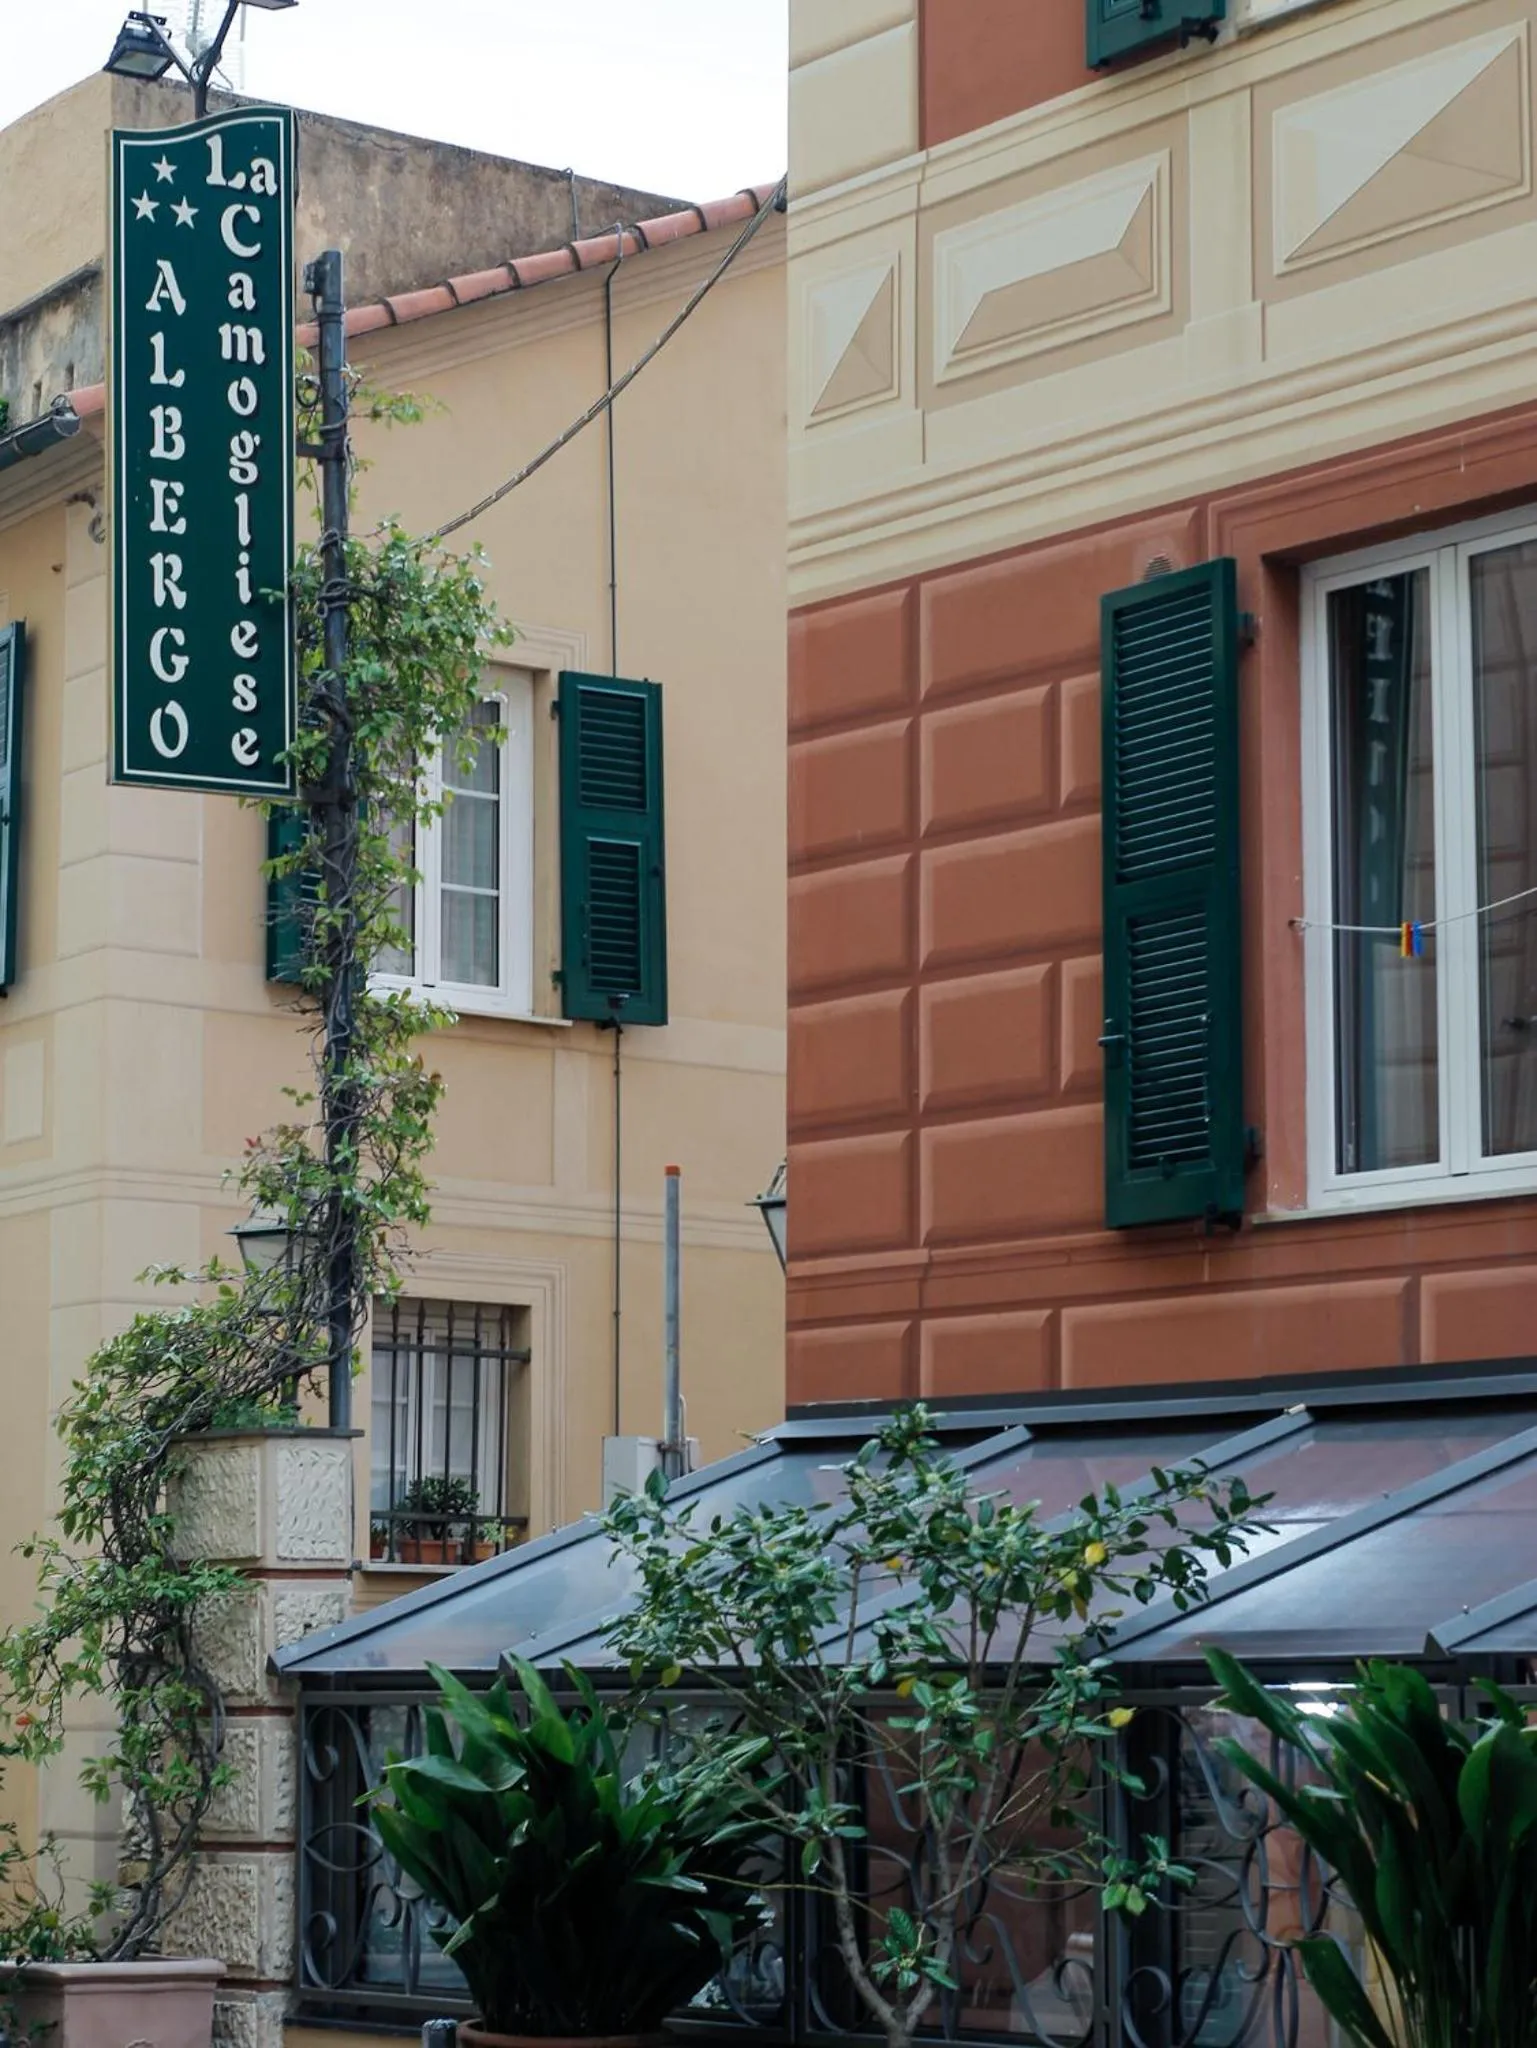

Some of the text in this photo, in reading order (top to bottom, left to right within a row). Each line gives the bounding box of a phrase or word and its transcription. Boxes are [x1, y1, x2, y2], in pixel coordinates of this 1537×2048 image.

[145, 259, 190, 758] ALBERGO
[206, 134, 278, 766] La Camogliese
